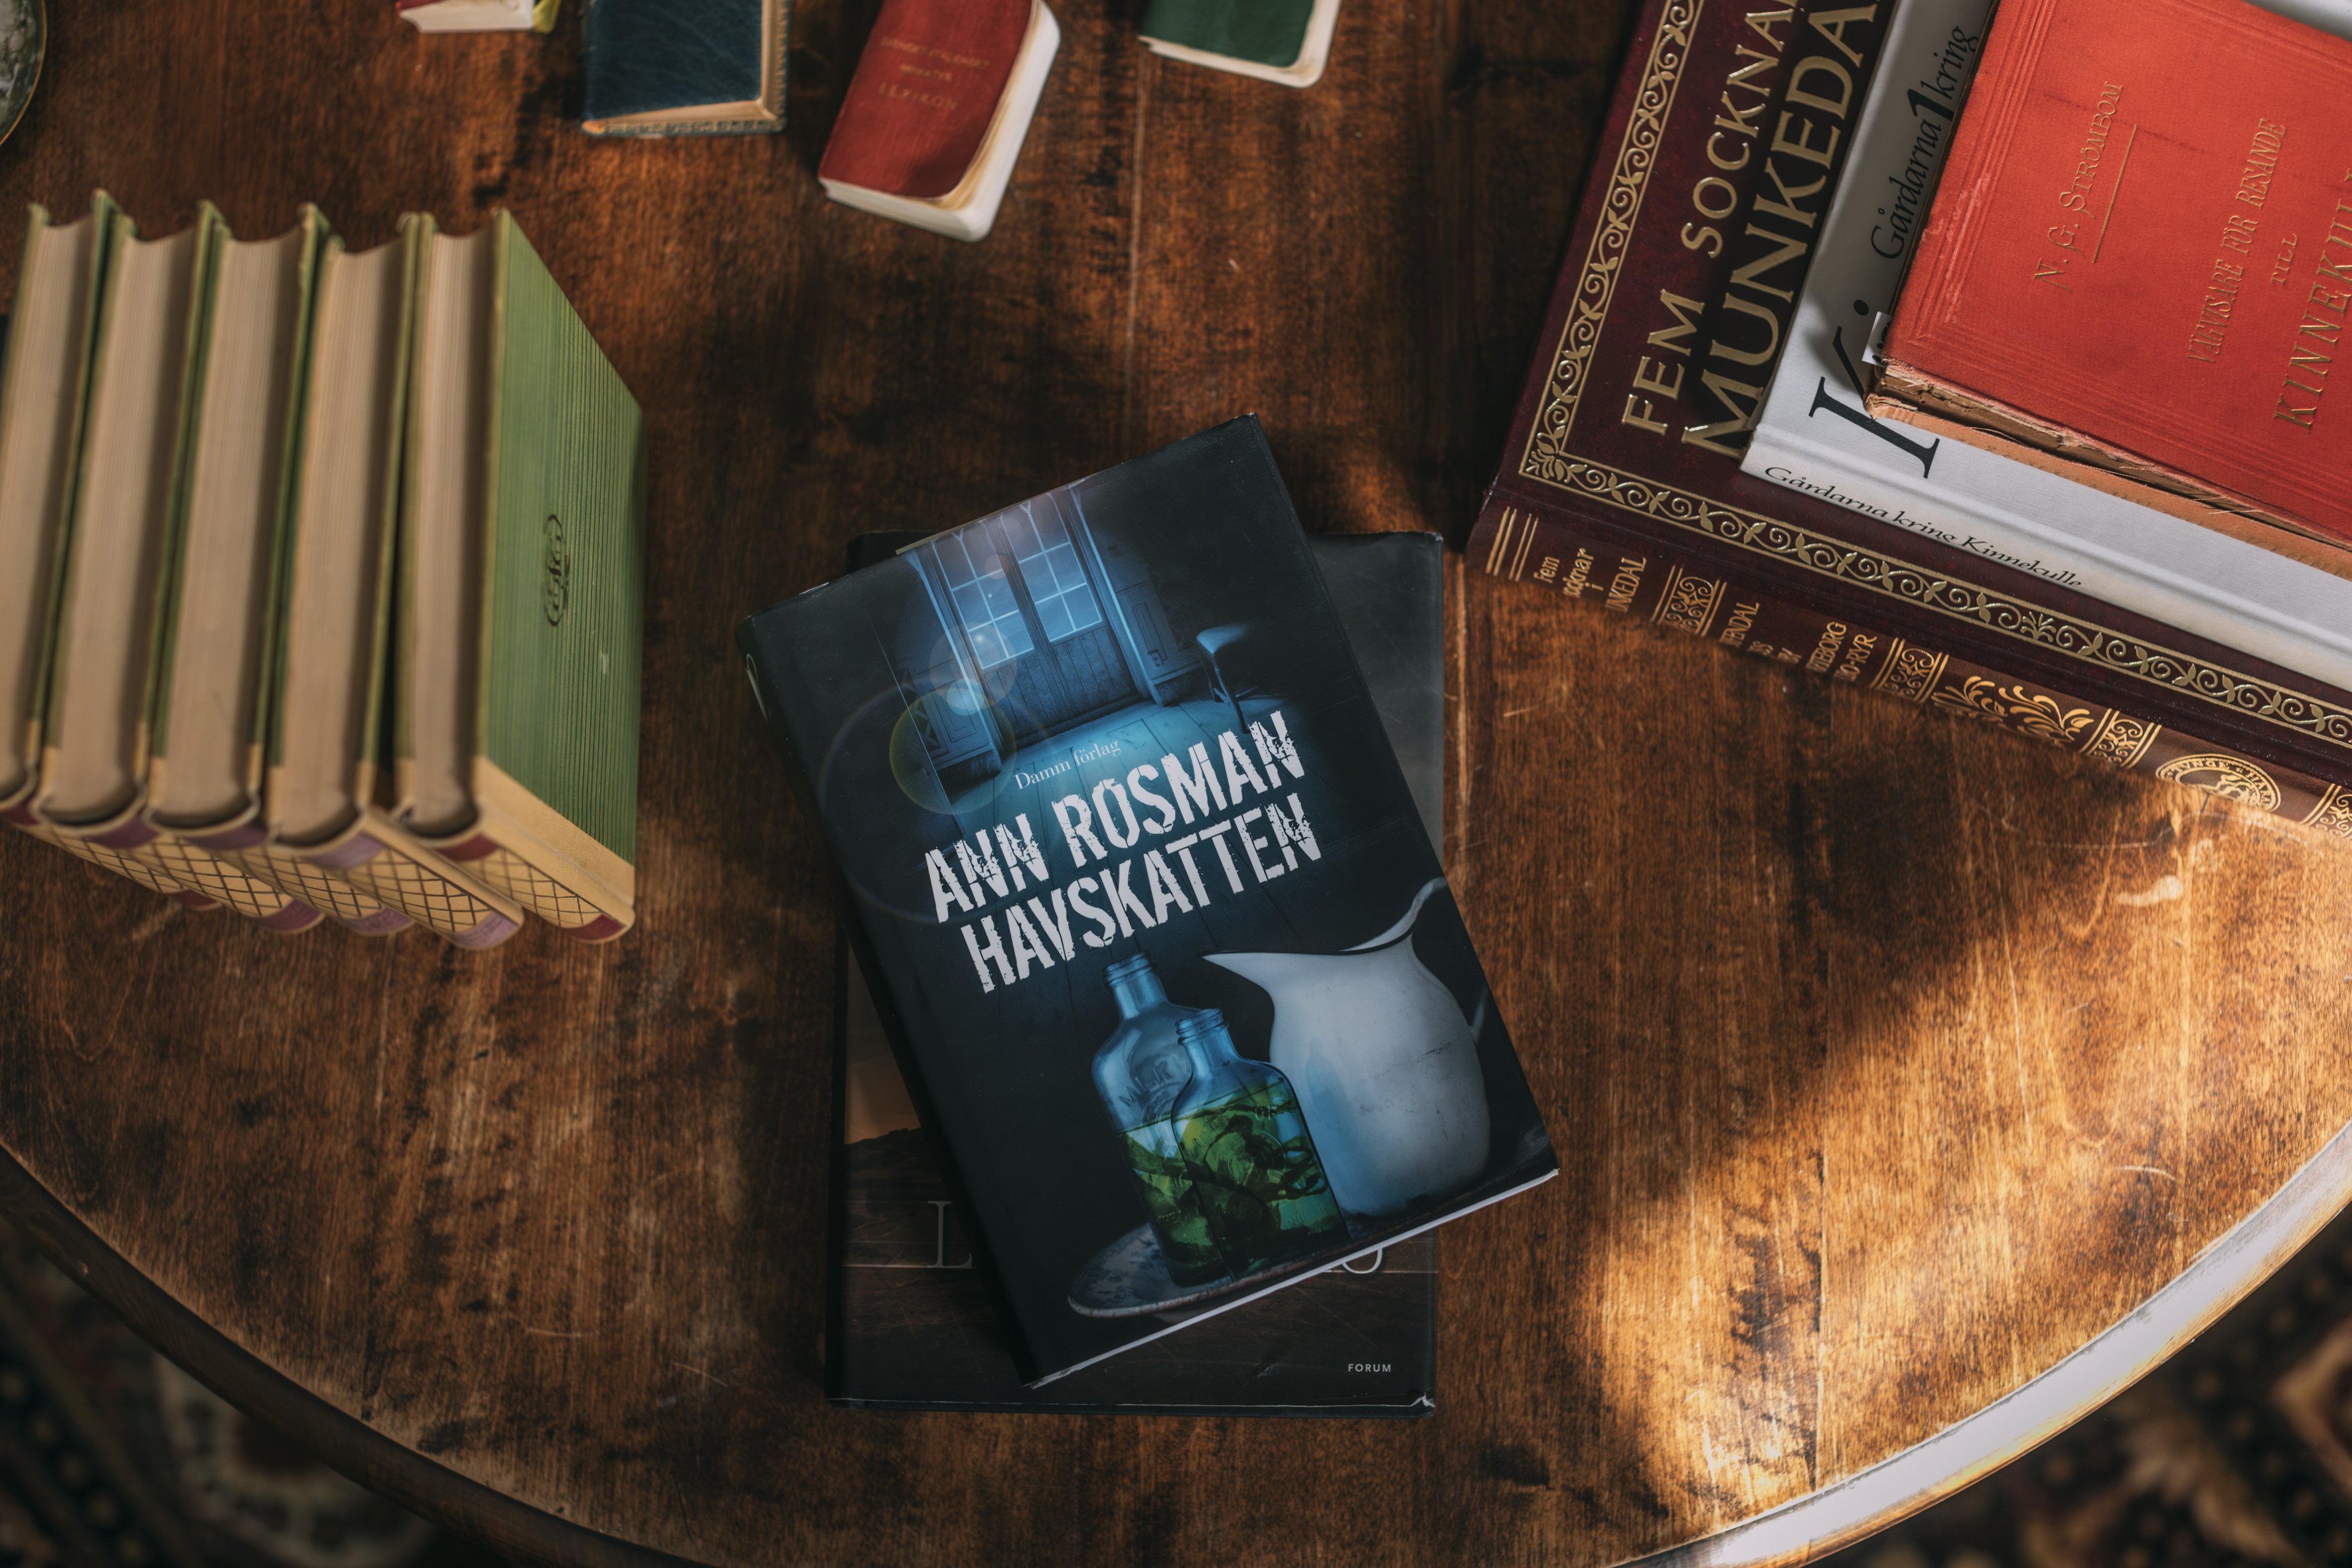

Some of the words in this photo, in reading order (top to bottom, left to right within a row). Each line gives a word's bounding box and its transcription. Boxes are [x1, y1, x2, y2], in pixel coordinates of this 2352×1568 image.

[1871, 118, 1942, 259] Gårdarna
[1921, 25, 1979, 100] kring
[2235, 118, 2286, 209] RESANDE
[1621, 289, 1705, 435] FEM
[1680, 0, 1798, 258] SOCKNA
[1682, 0, 1879, 459] MUNKEDA
[2048, 224, 2085, 258] G.
[2221, 215, 2258, 256] FÖR
[2034, 258, 2072, 293] N.
[2270, 233, 2298, 287] TILL
[2187, 259, 2244, 363] VÄGVISARE
[1765, 467, 1888, 518] Gårdarna
[1893, 510, 1957, 543] kring
[1962, 536, 2082, 588] Kinnekulle
[1533, 556, 1559, 584] Fem
[1585, 582, 1604, 591] i
[1605, 557, 1647, 612] UNKEDAL
[1013, 760, 1071, 791] Damm
[1073, 738, 1122, 769] förlag
[925, 813, 1050, 923] ANN
[1052, 710, 1305, 868] ROSMAN
[961, 793, 1321, 994] HAVSKATTEN
[1348, 1364, 1391, 1372] FORUM
